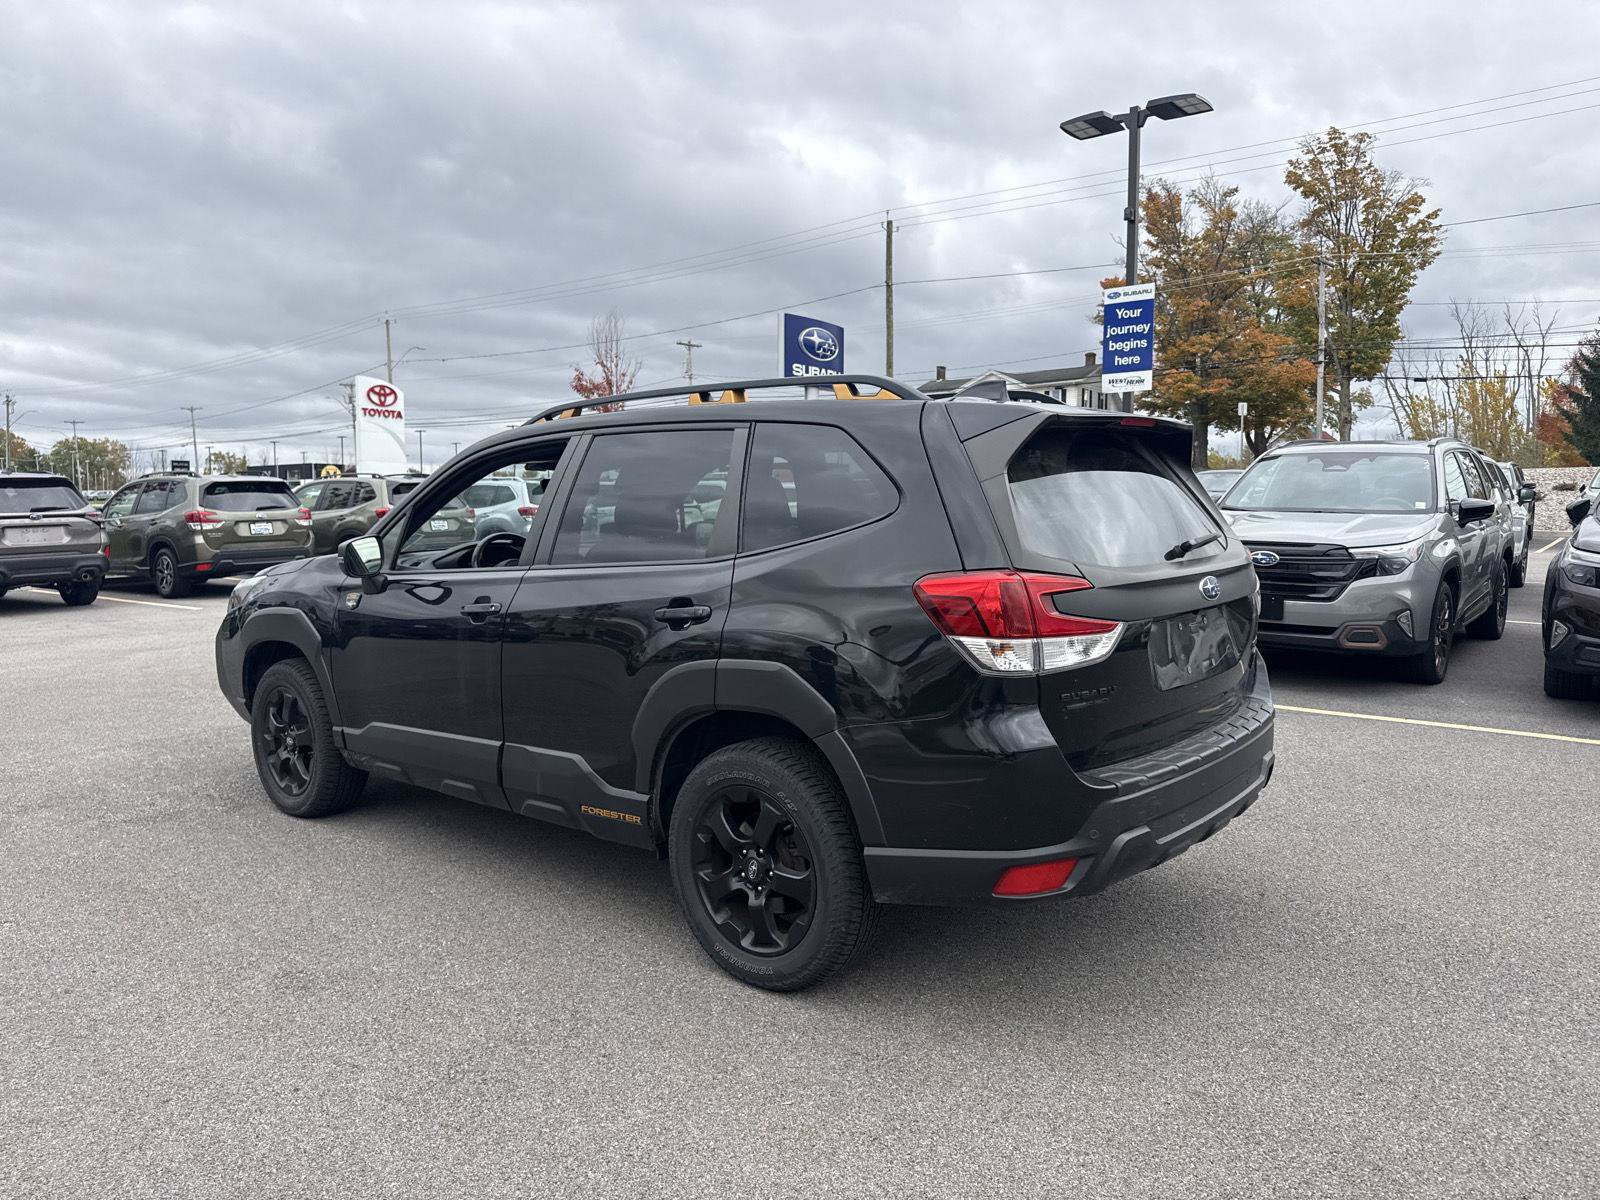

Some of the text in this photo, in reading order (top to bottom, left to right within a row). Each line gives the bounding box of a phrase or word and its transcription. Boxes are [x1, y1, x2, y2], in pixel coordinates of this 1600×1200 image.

[1122, 289, 1152, 297] SUBARU
[1116, 308, 1142, 319] Your
[1106, 323, 1151, 338] journey
[1109, 338, 1148, 352] begins
[1114, 355, 1140, 366] here
[361, 407, 403, 419] TOYOTA
[581, 805, 641, 825] FORESTER
